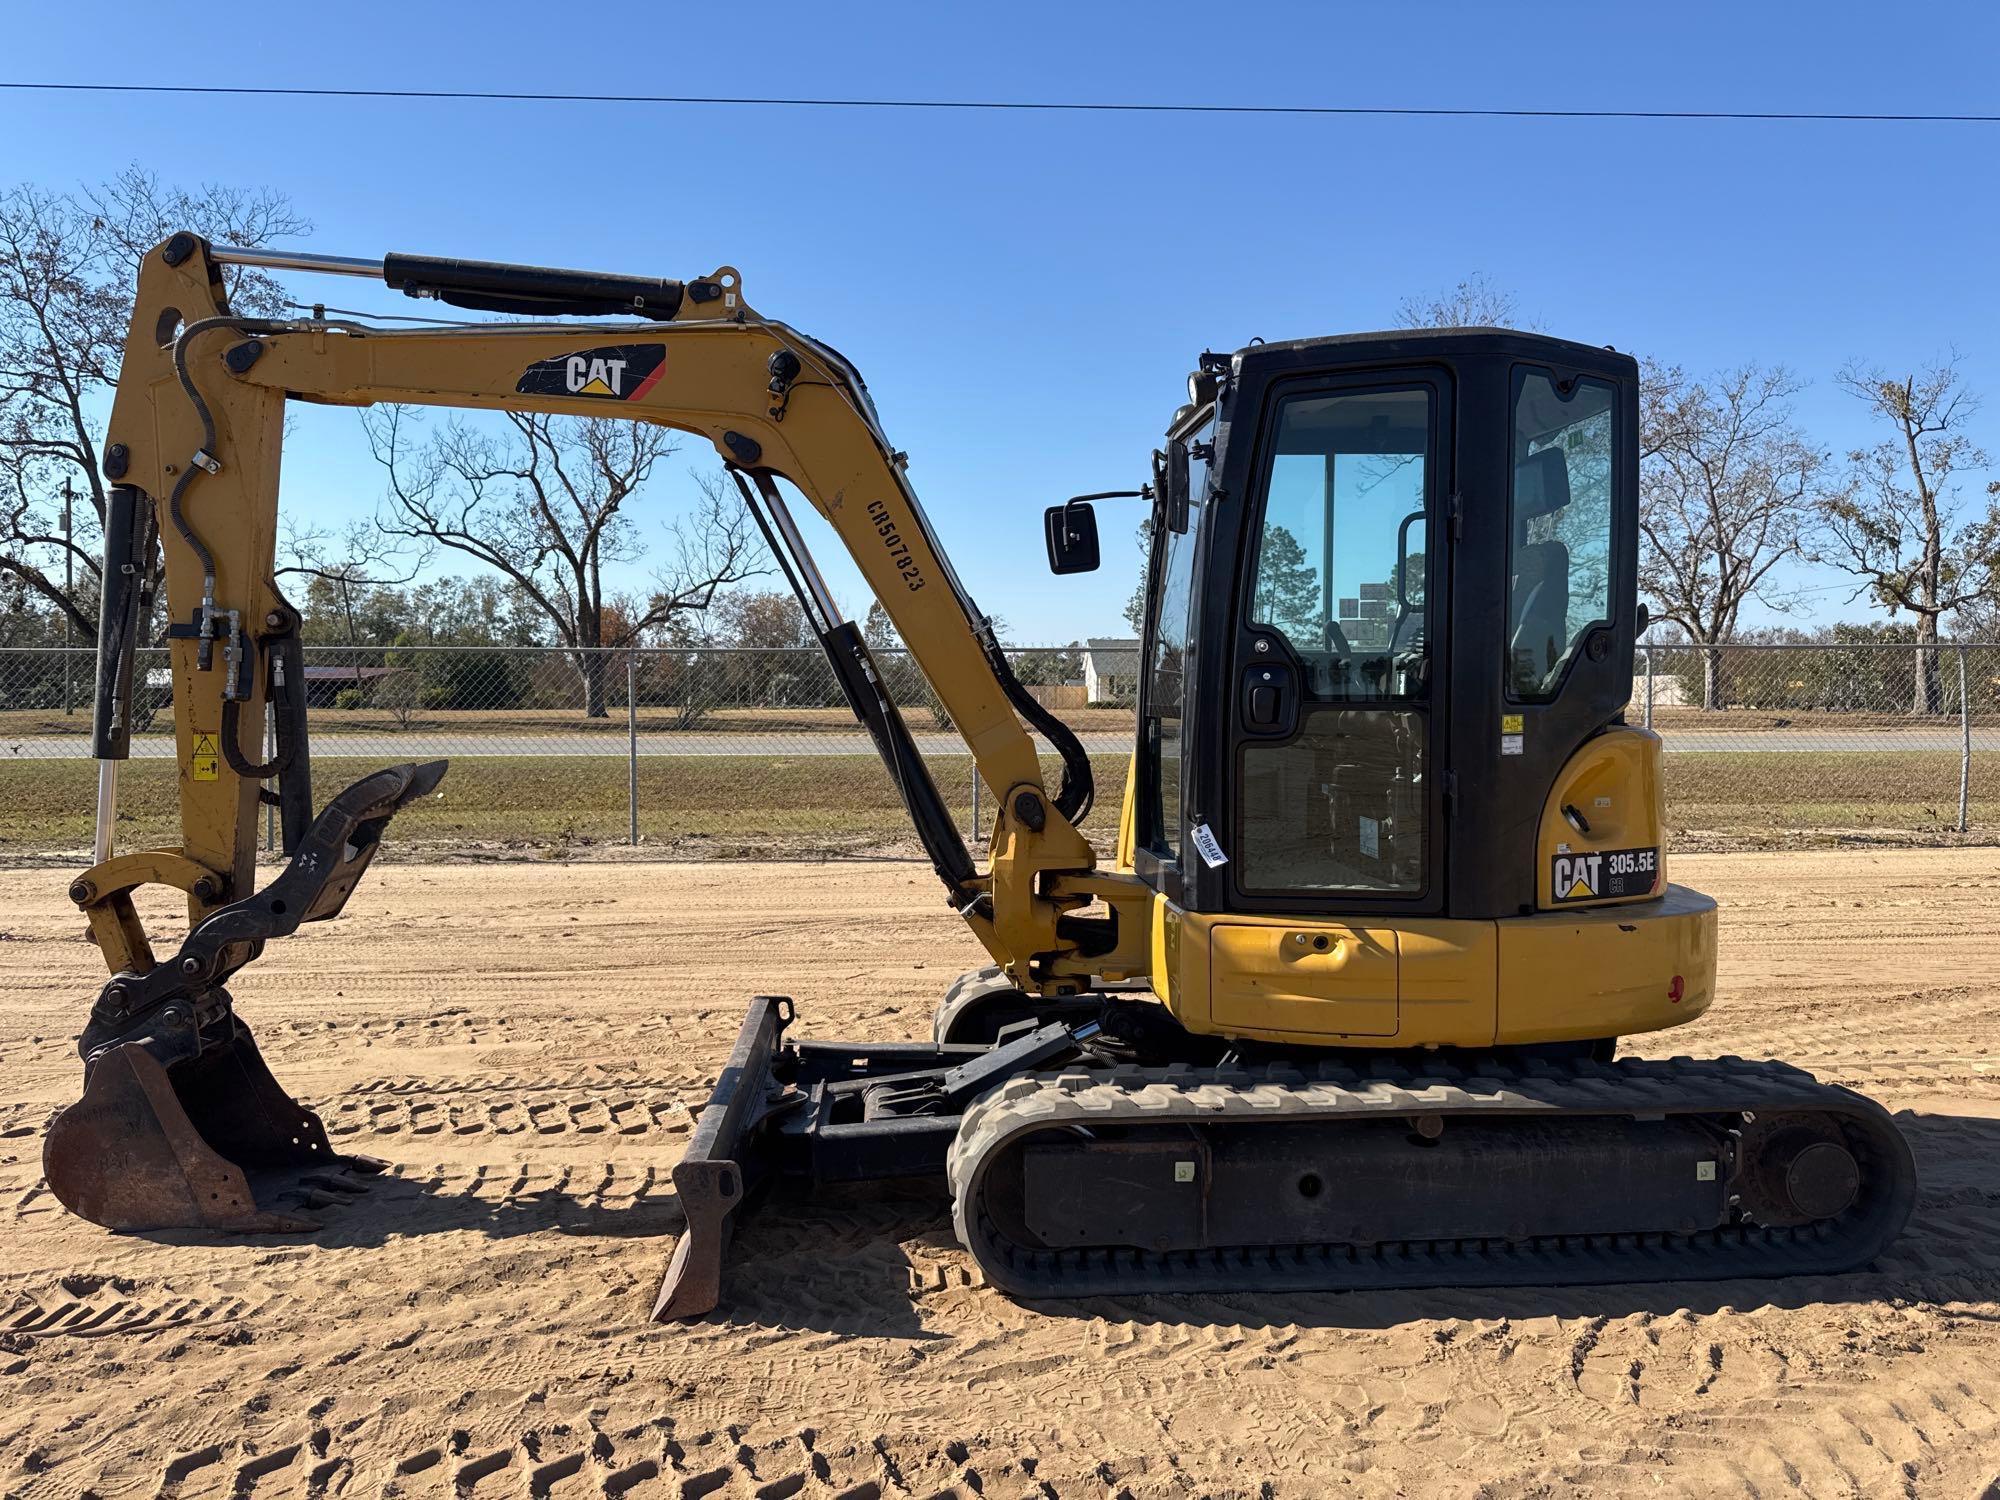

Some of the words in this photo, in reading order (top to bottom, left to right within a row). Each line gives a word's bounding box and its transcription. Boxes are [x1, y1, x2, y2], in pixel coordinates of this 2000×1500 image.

[566, 356, 626, 396] CAT
[867, 500, 926, 592] CR507823
[1555, 856, 1602, 899] CAT
[1609, 851, 1655, 875] 305.5E
[1608, 878, 1624, 893] CR
